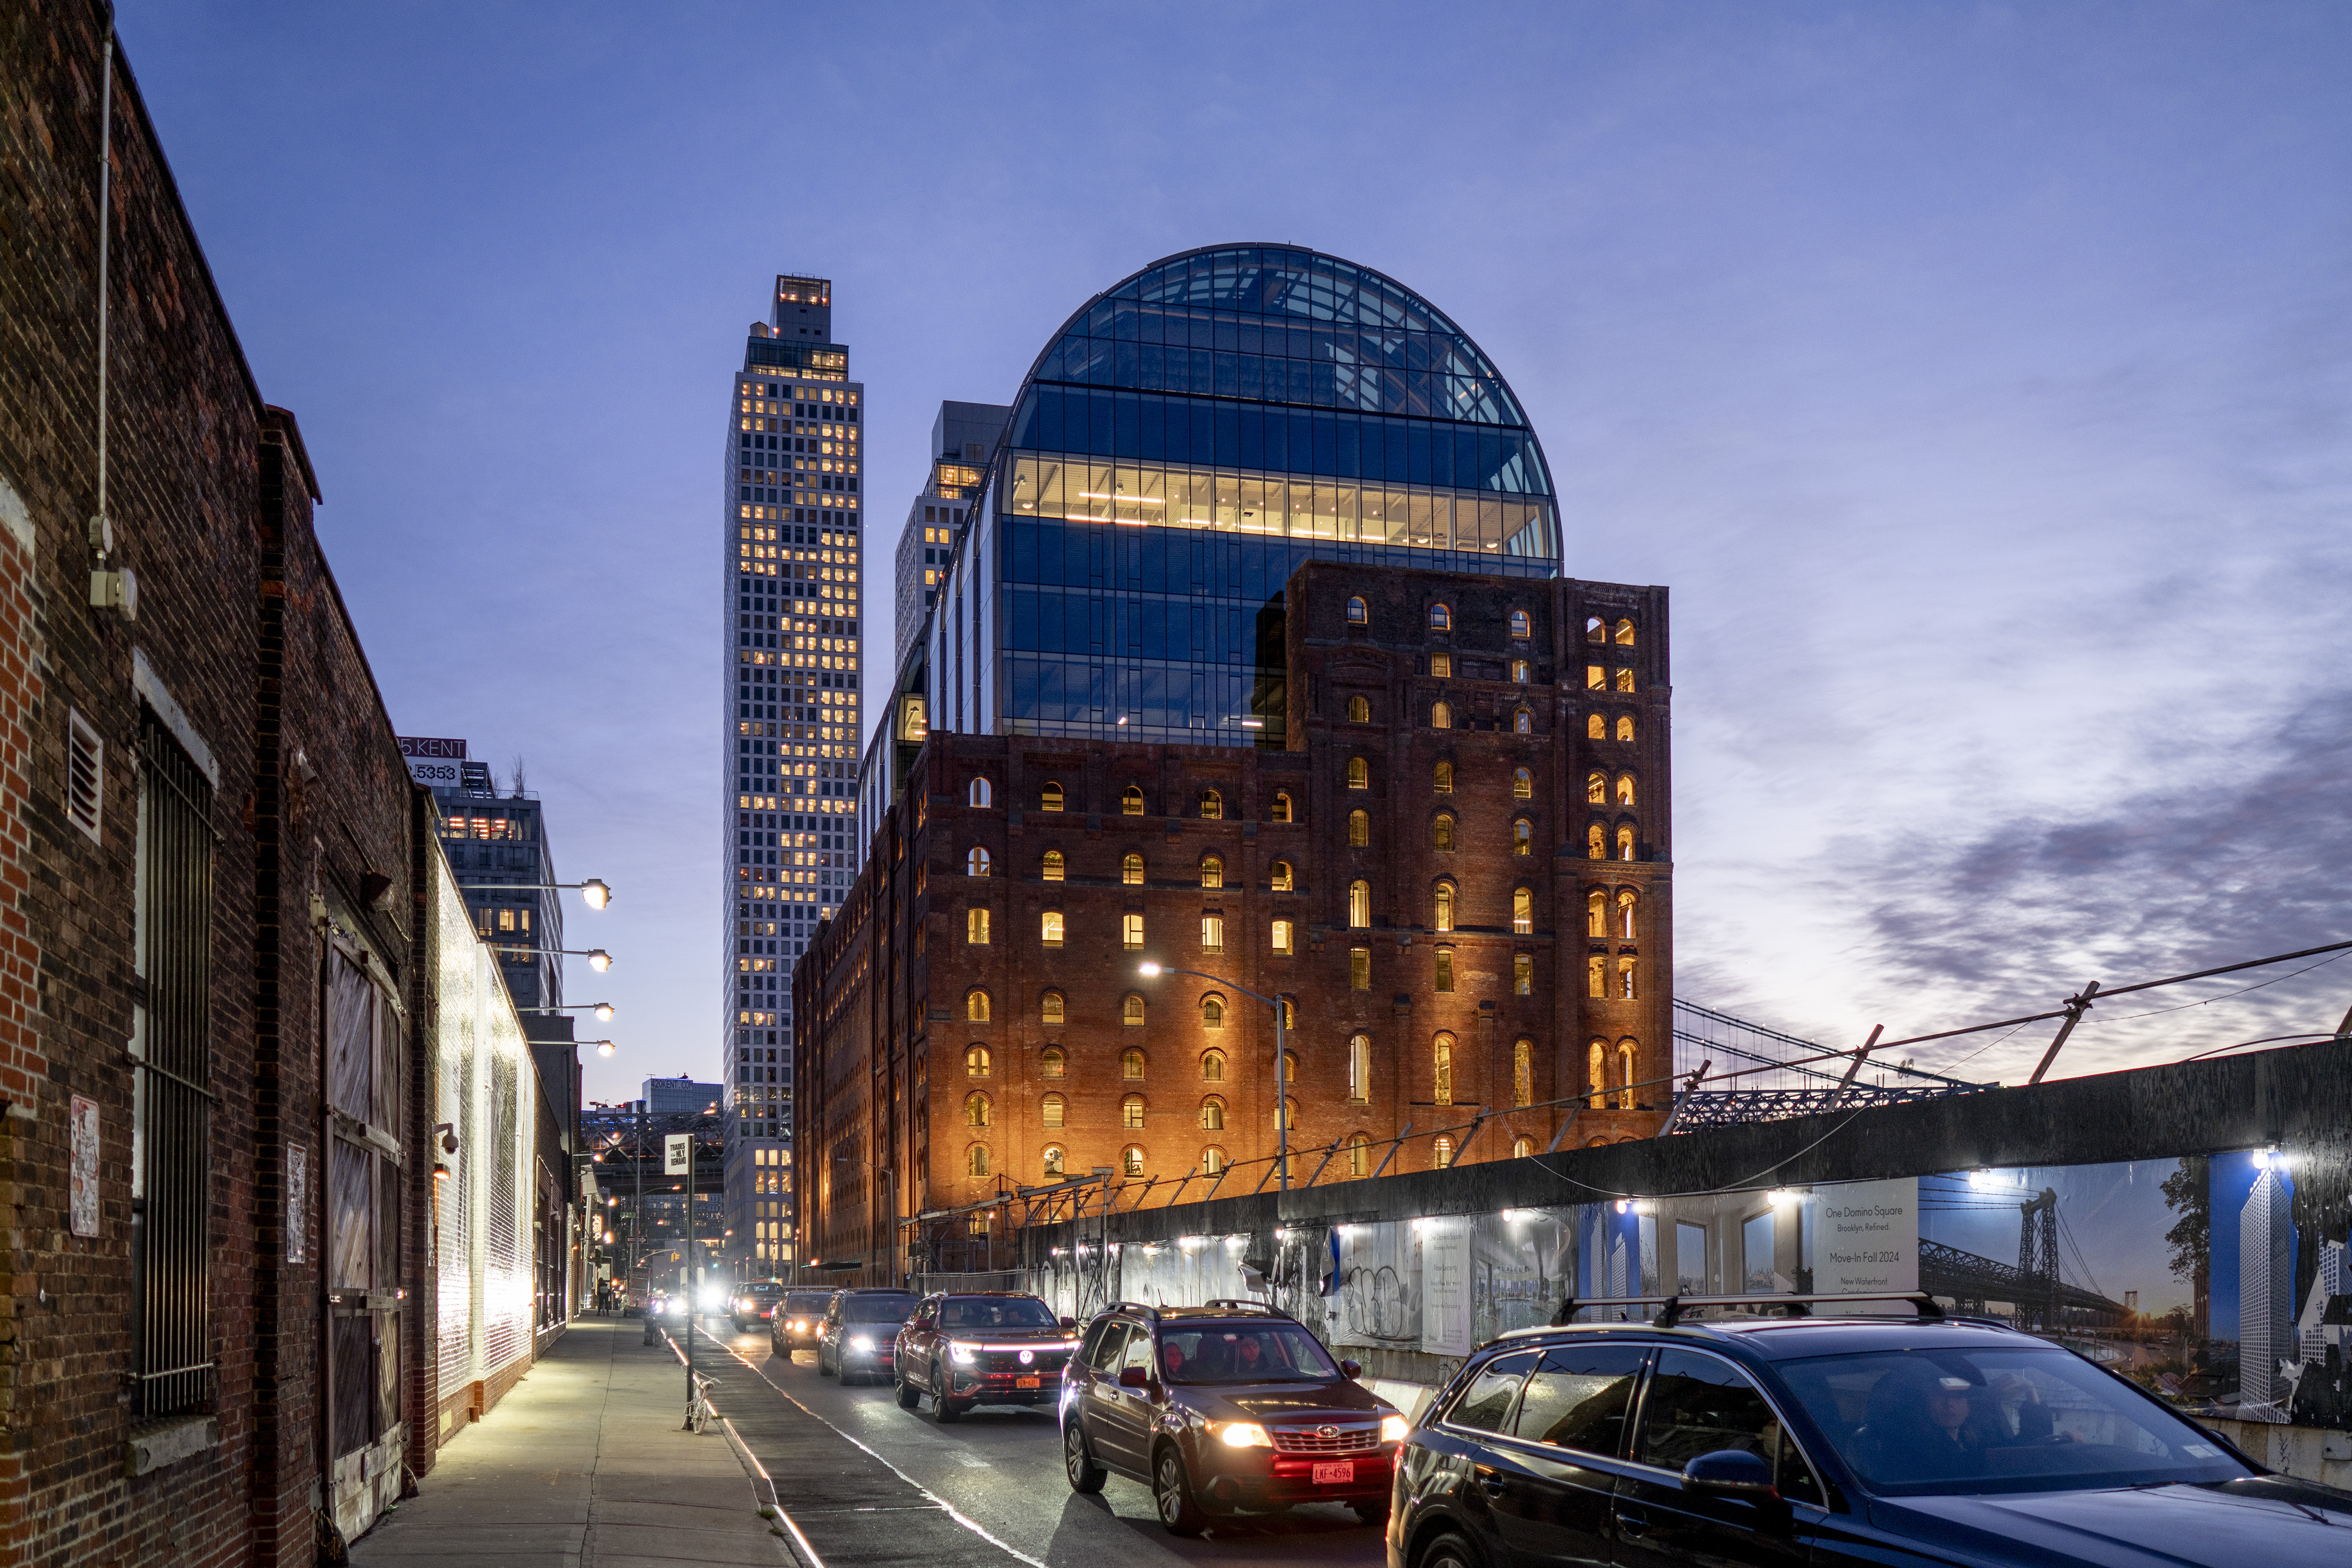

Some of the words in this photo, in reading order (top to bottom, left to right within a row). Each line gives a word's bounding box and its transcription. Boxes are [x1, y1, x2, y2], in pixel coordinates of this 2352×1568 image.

[417, 739, 464, 757] KENT
[409, 765, 455, 780] .5353
[651, 1079, 693, 1090] 420KENT.COM
[670, 1142, 685, 1151] TRADES
[1826, 1208, 1842, 1218] One
[1844, 1207, 1873, 1217] Domino
[1875, 1205, 1903, 1218] Square
[1838, 1223, 1864, 1234] Brooklyn,
[1865, 1222, 1890, 1231] Refined.
[1830, 1252, 1861, 1263] Move-In
[1863, 1252, 1877, 1263] Fall
[1879, 1251, 1899, 1262] 2024
[1855, 1277, 1887, 1285] Waterfront
[1334, 1467, 1351, 1478] 4596
